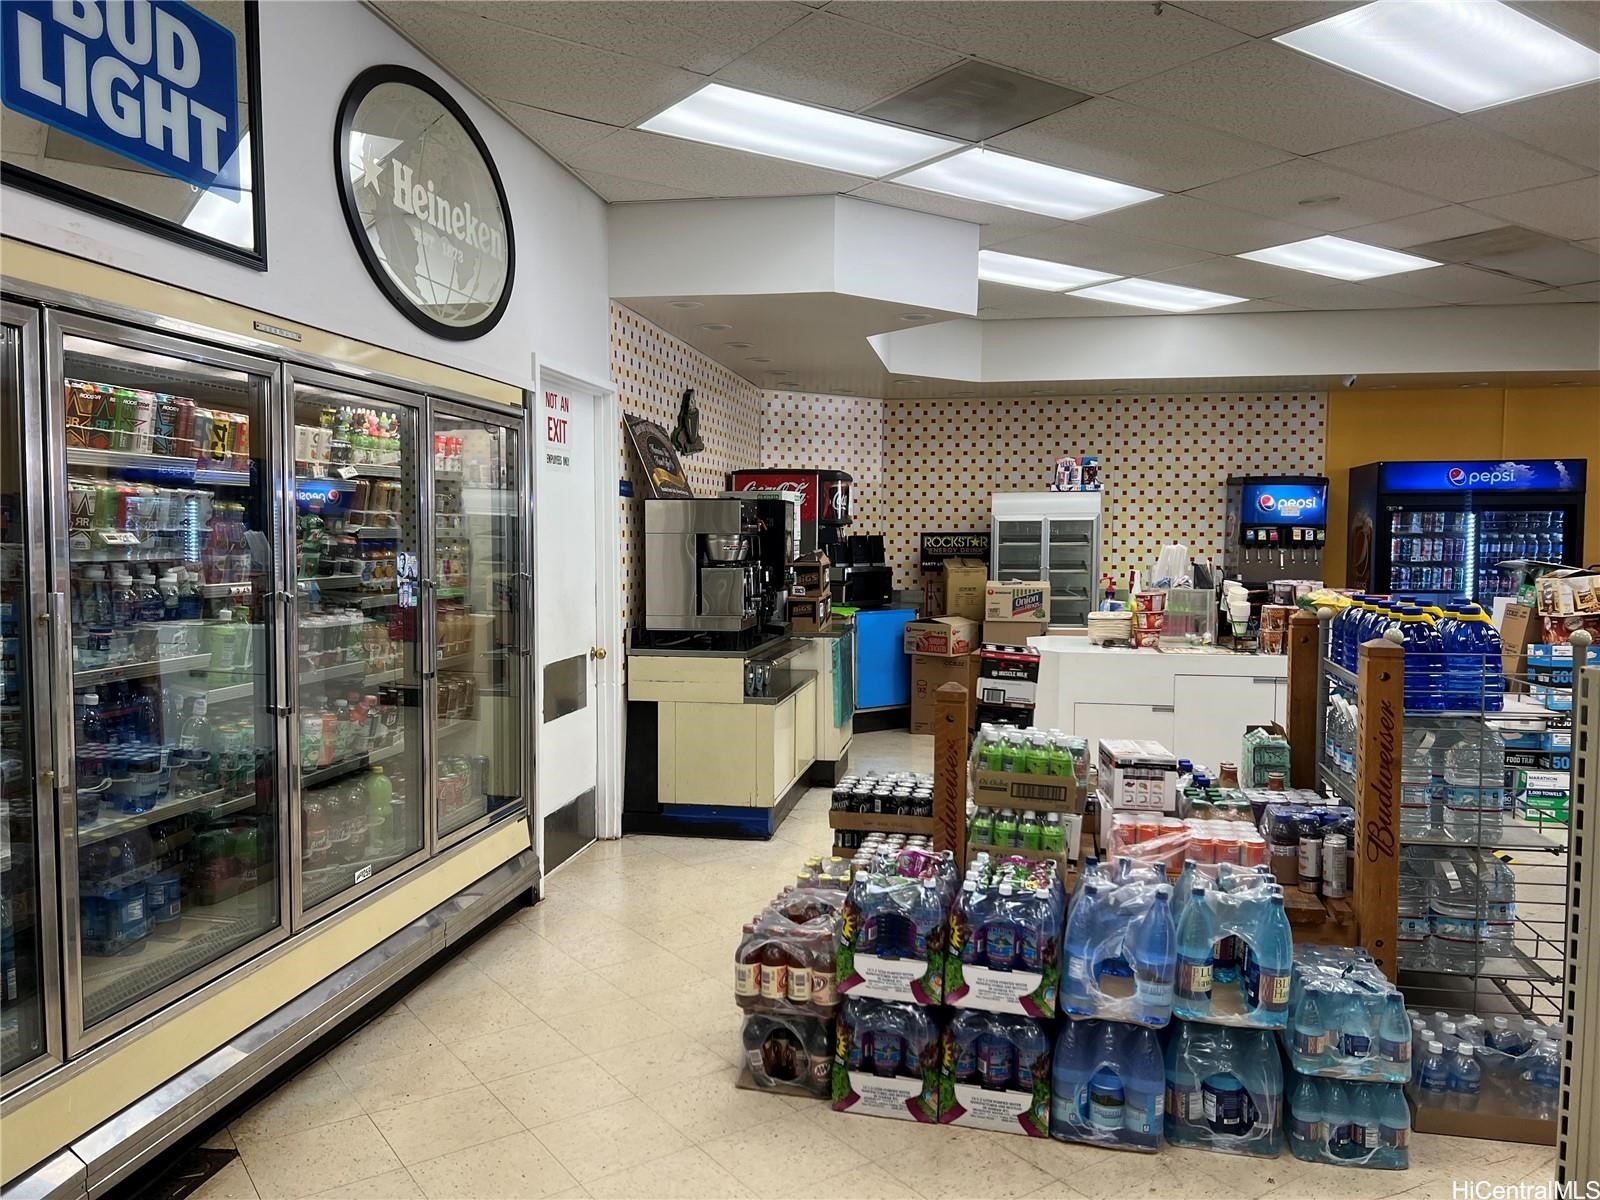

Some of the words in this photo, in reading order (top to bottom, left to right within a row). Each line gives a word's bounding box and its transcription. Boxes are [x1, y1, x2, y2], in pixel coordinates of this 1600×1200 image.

[17, 9, 228, 176] LIGHT
[391, 157, 503, 261] Heineken
[545, 392, 557, 409] NOT
[560, 395, 570, 413] AN
[547, 416, 568, 444] EXIT
[1469, 469, 1516, 485] pepsi
[1278, 497, 1316, 511] pepsi
[1015, 594, 1040, 607] Onion
[1506, 756, 1521, 764] FOOD
[1366, 699, 1396, 863] Budweiser
[938, 738, 959, 851] udweiser
